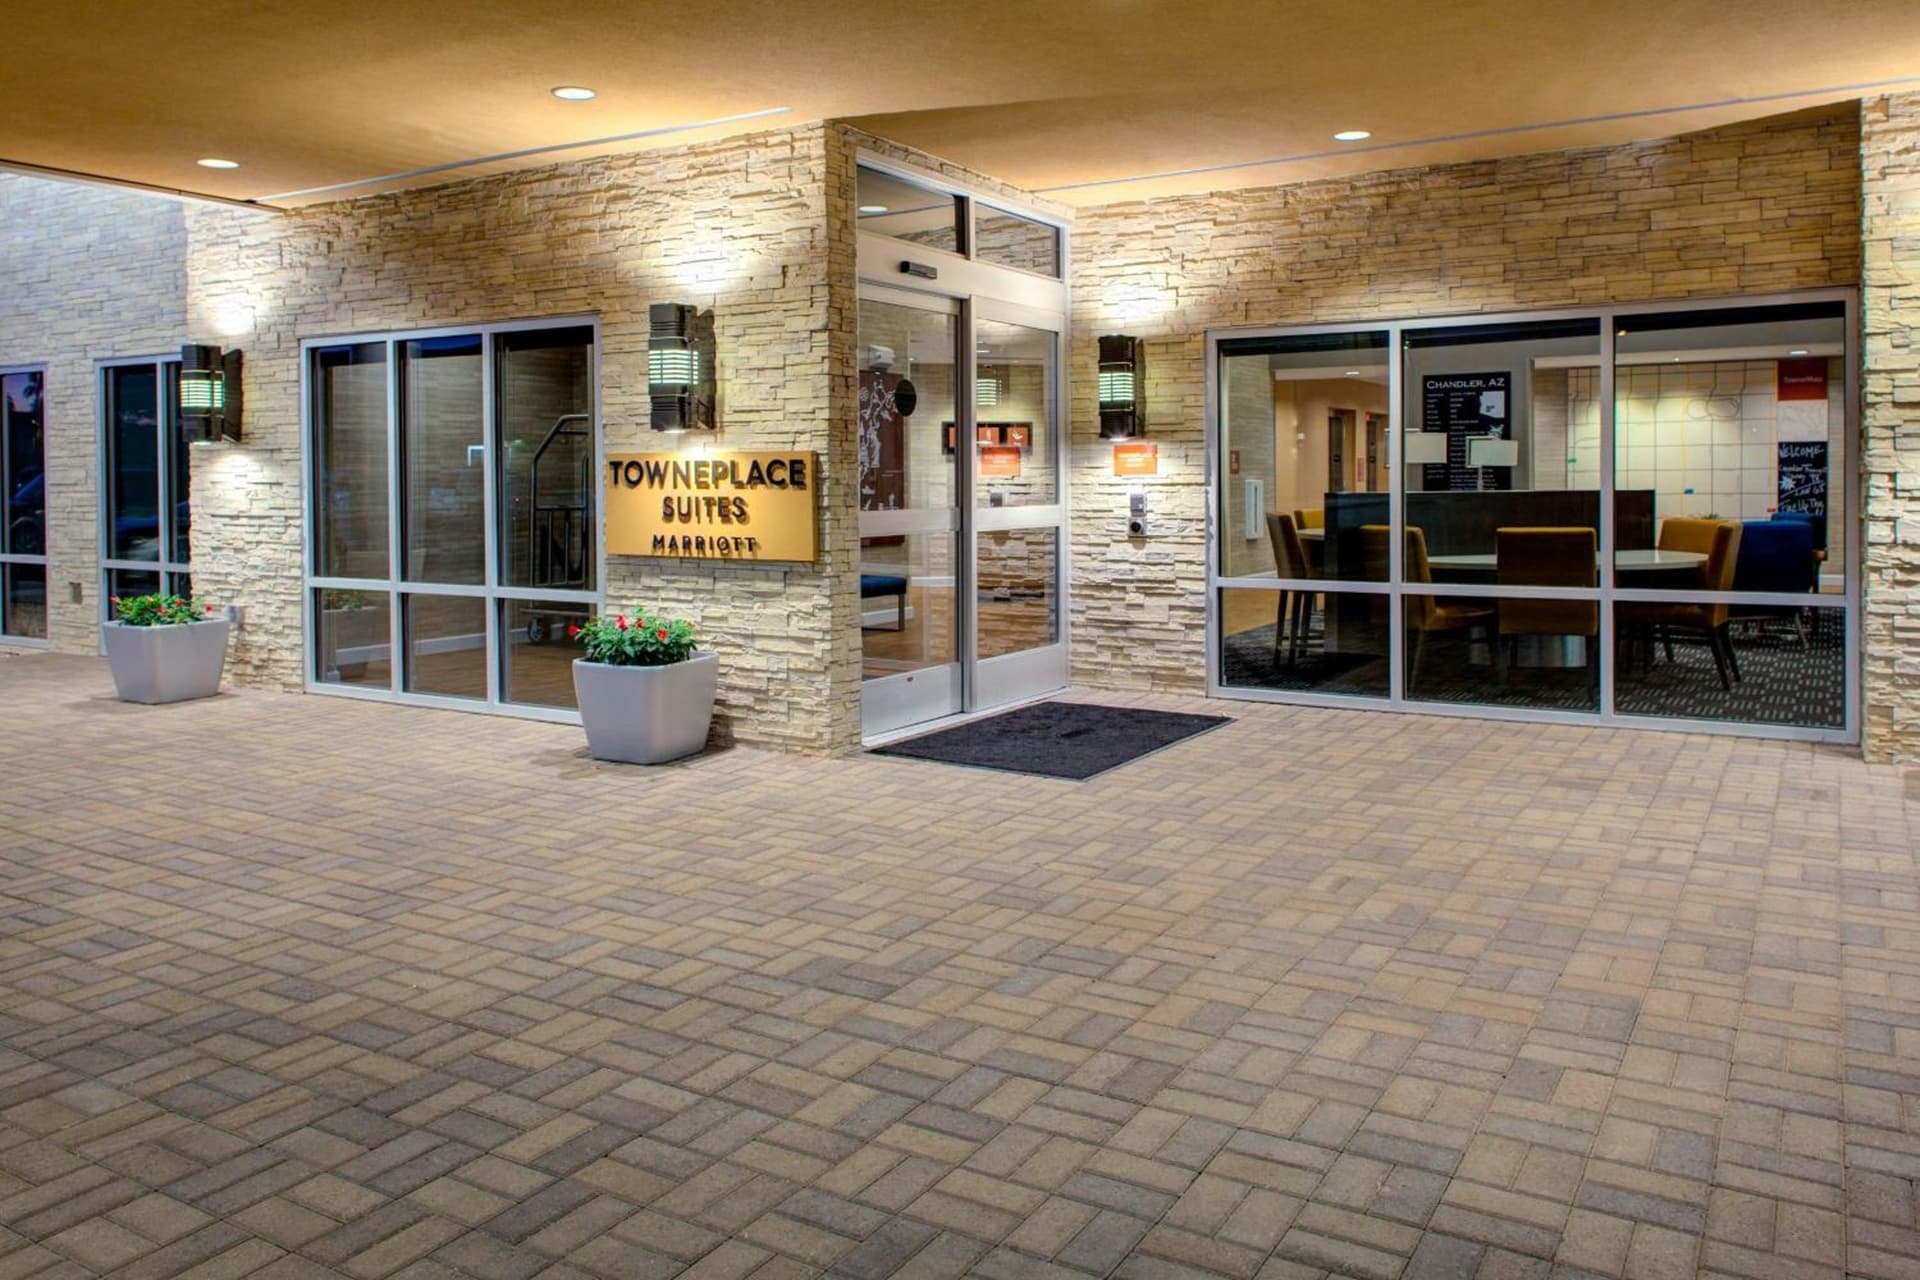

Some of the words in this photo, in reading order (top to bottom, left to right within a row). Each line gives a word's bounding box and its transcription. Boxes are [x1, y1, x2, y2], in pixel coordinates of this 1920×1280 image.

[1489, 377, 1505, 387] AZ
[609, 459, 807, 489] TOWNEPLACE
[662, 496, 748, 522] SUITES
[652, 535, 759, 555] MARRIOTT
